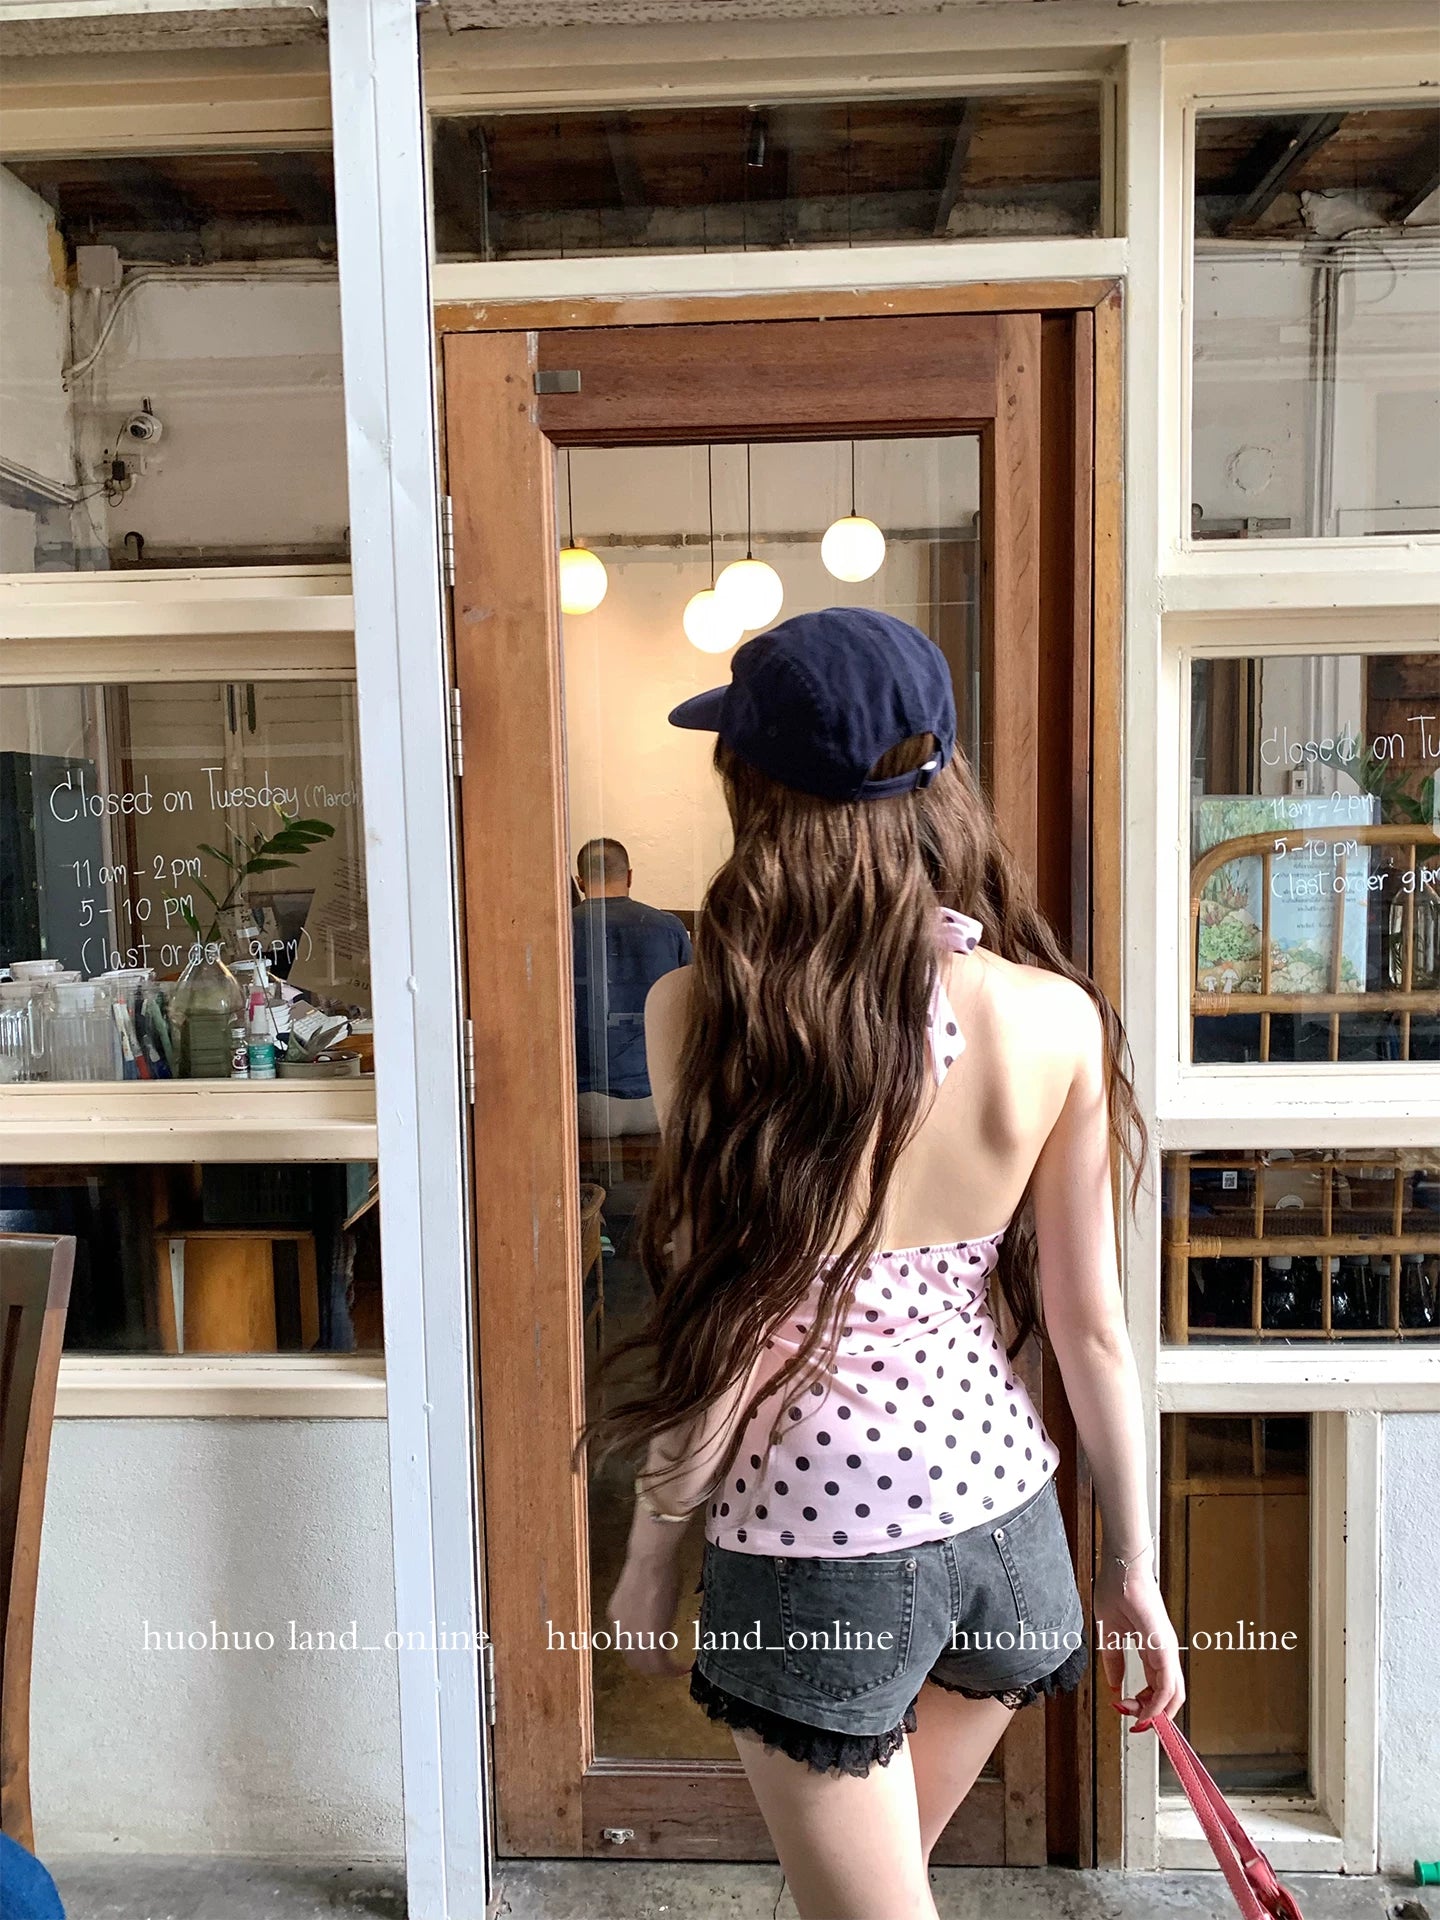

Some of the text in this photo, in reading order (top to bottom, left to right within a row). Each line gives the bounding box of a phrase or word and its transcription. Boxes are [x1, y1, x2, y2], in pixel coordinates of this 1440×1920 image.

[1260, 719, 1356, 766] Closed
[1372, 733, 1405, 760] on
[50, 769, 153, 823] Closed
[163, 789, 193, 813] on
[200, 766, 300, 819] Tuesday
[1332, 872, 1390, 894] order
[81, 933, 152, 975] (last
[160, 929, 226, 967] order
